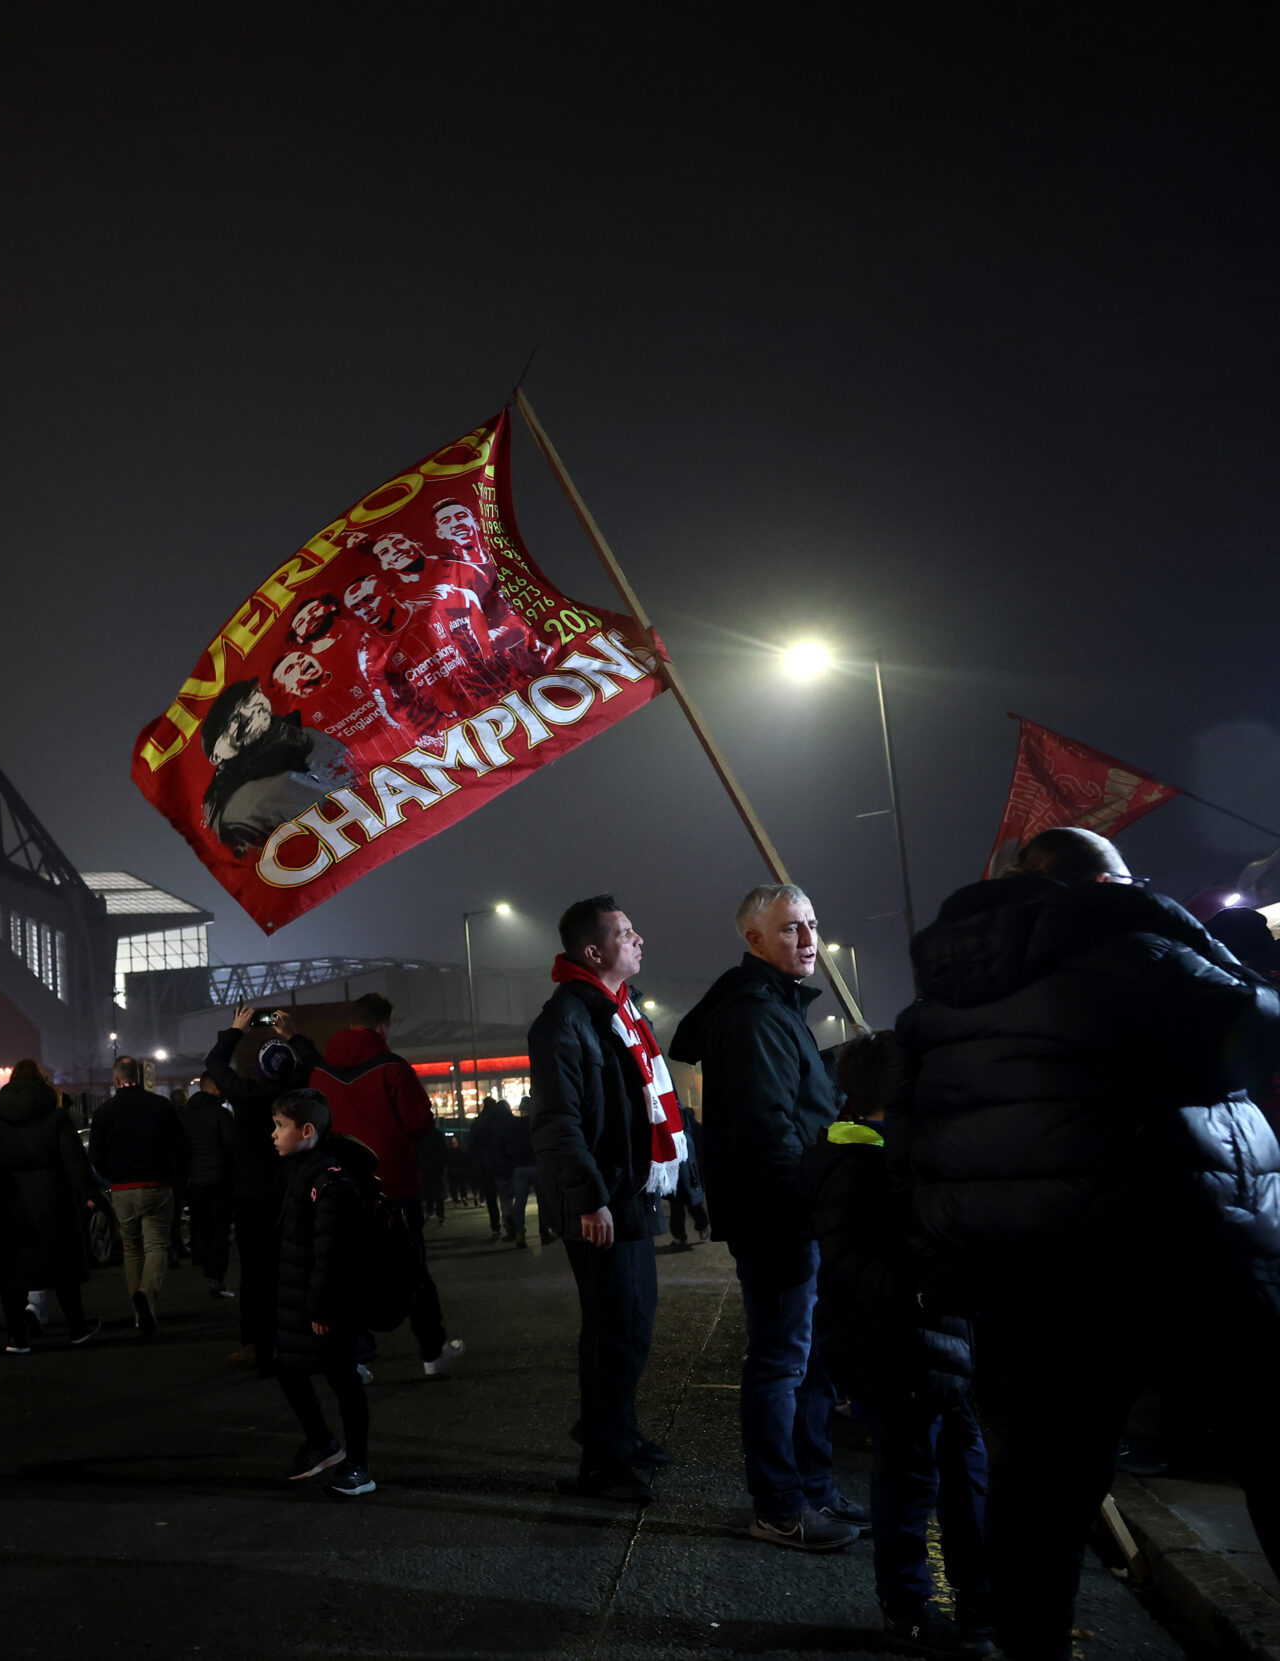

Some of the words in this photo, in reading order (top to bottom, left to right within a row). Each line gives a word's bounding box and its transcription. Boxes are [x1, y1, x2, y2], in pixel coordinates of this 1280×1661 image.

[140, 427, 496, 773] LIVERPOO
[404, 644, 456, 682] Champions
[324, 700, 376, 735] Champions
